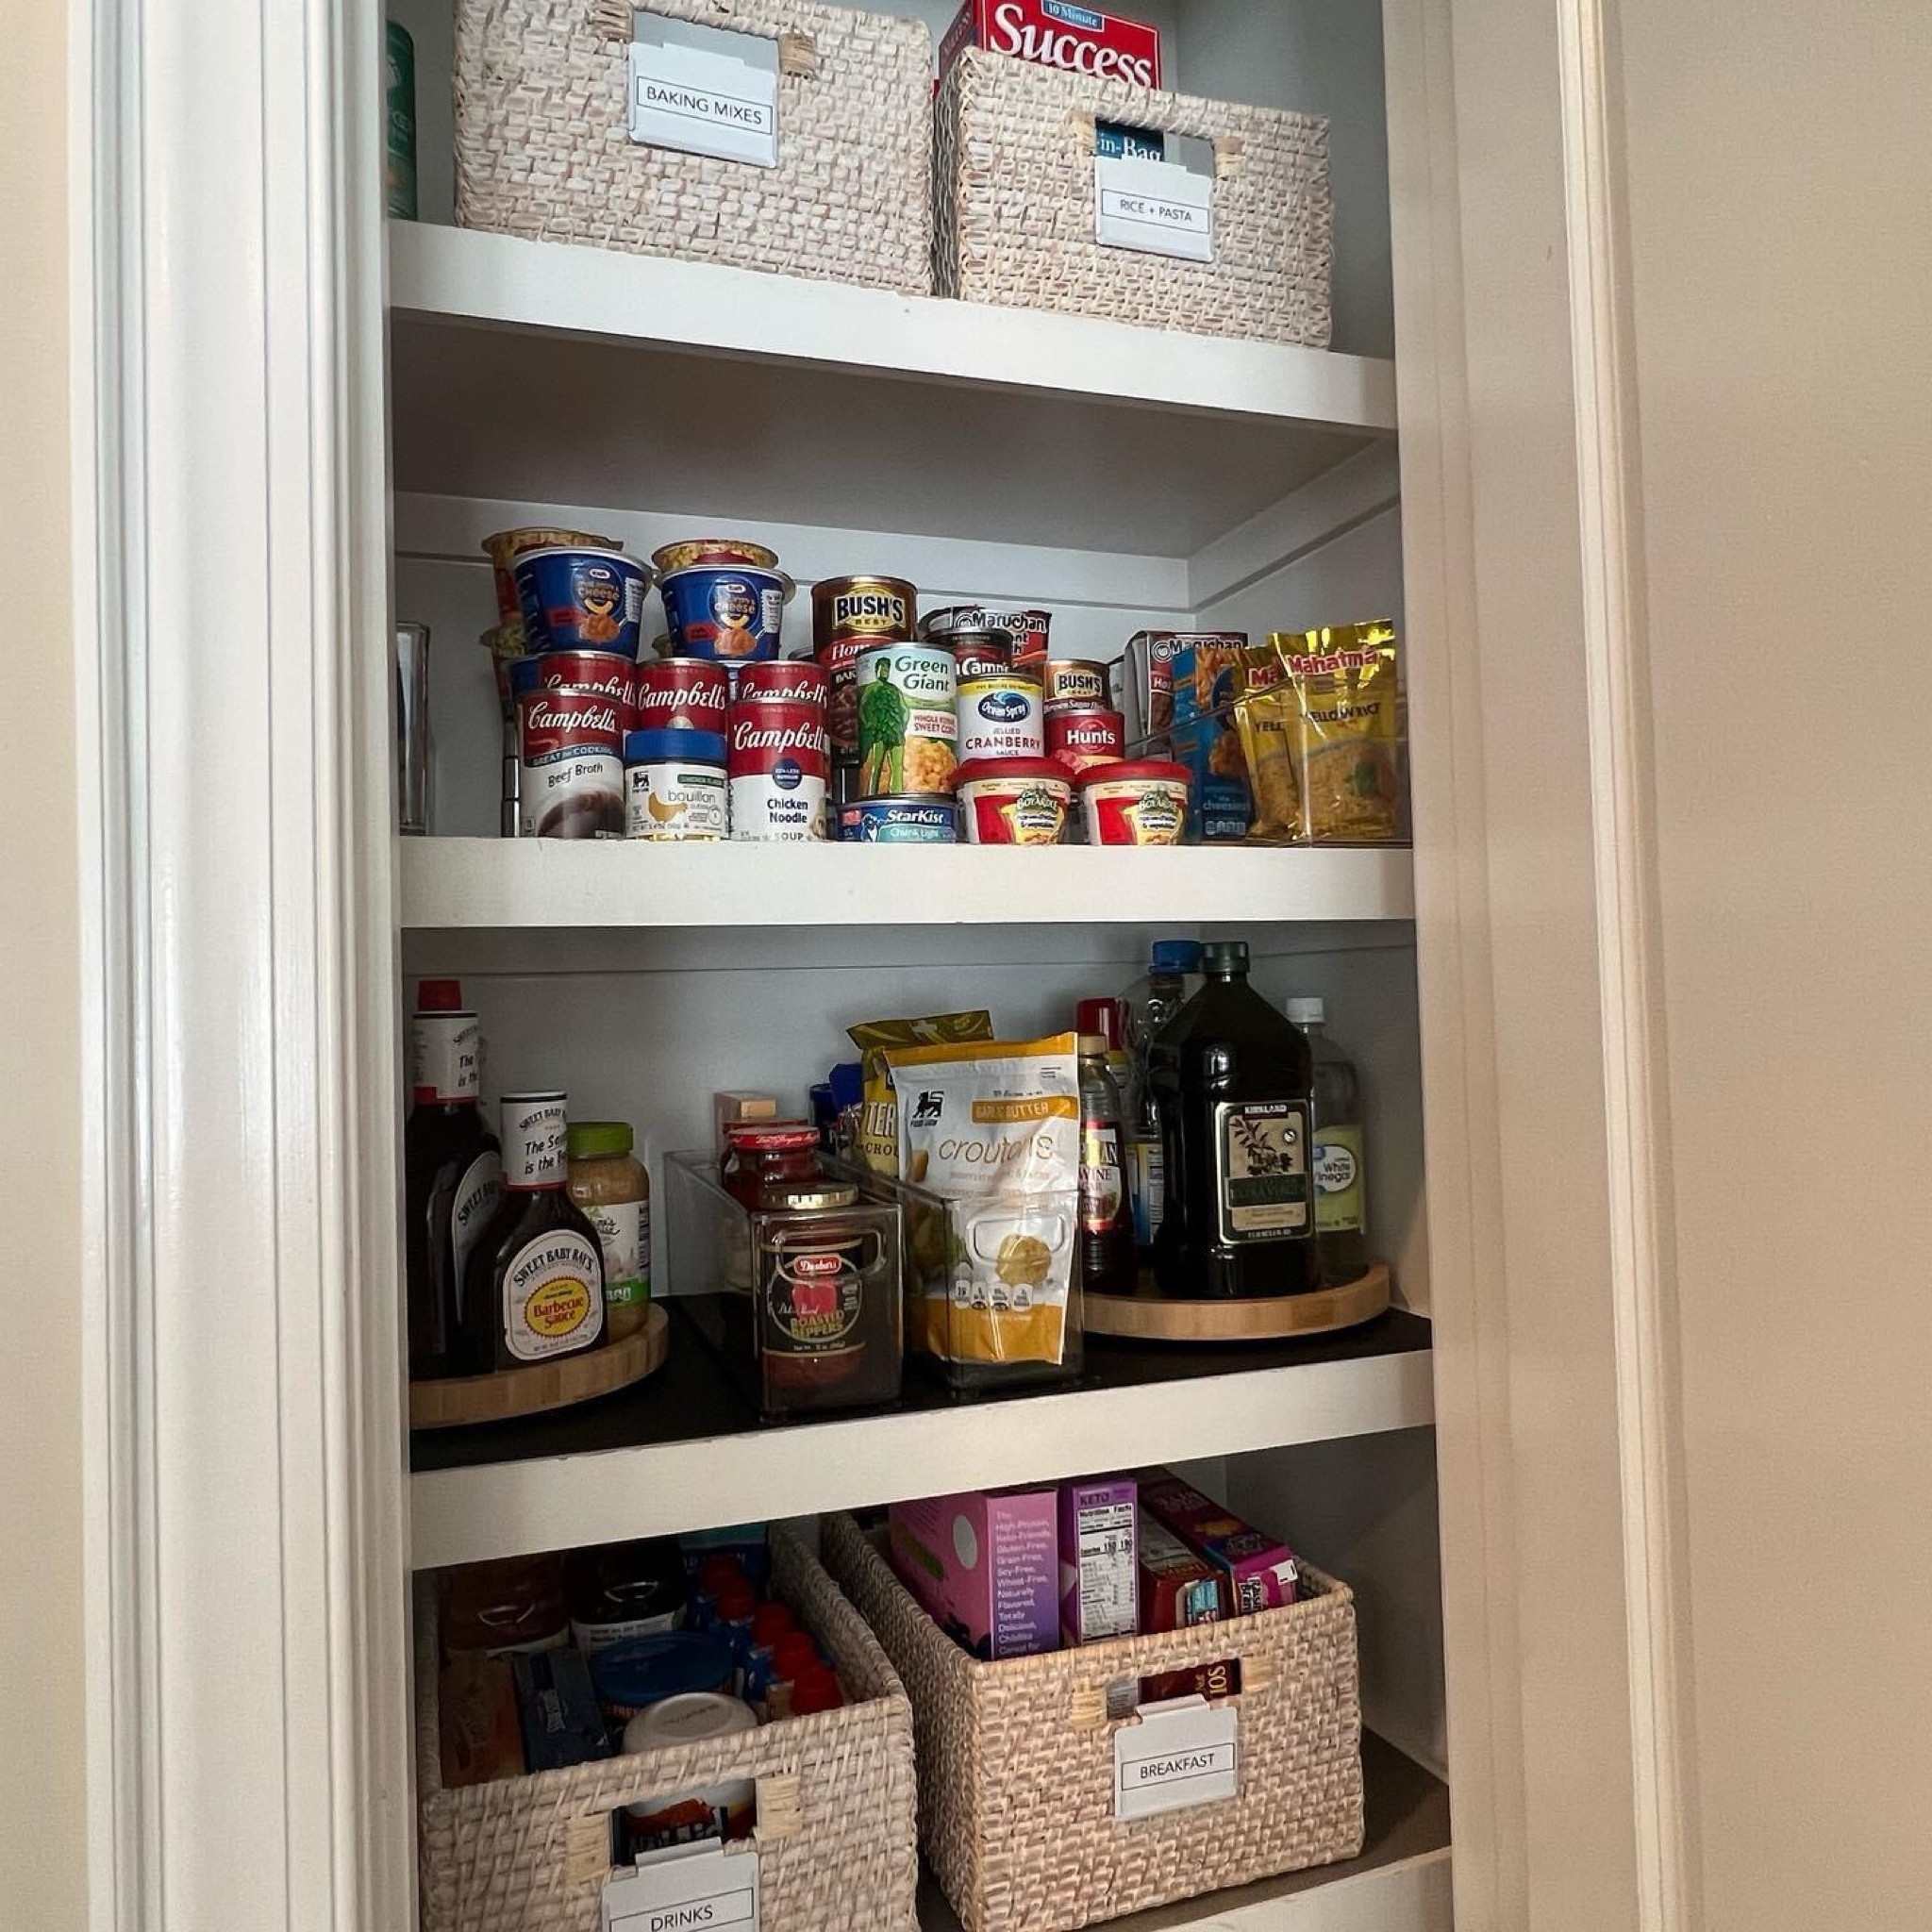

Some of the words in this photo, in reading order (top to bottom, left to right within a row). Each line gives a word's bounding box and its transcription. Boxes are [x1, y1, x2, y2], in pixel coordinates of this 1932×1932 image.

[1061, 7, 1099, 27] Minute
[990, 3, 1153, 89] Success
[647, 85, 709, 113] BAKING
[713, 100, 762, 125] MIXES
[1120, 198, 1145, 214] RICE
[1158, 205, 1193, 223] PASTA
[836, 595, 903, 624] BUSH'S
[973, 611, 1046, 631] Maruchan
[895, 656, 949, 675] Green
[1286, 647, 1381, 675] Mahatma
[903, 673, 949, 692] Giant
[639, 680, 725, 711] Campbell's
[528, 701, 619, 733] Campbell's
[914, 723, 941, 732] SWEET
[965, 736, 1041, 751] CRANBERRY
[547, 770, 573, 789] Beef
[575, 762, 604, 777] Broth
[667, 790, 716, 803] bouillon
[766, 797, 808, 810] Chicken
[769, 811, 808, 824] Noodle
[886, 809, 944, 824] StarKist
[525, 1141, 545, 1157] The
[525, 1161, 534, 1175] is
[539, 1156, 555, 1172] the
[513, 1254, 545, 1288] SWEET
[545, 1247, 572, 1263] BABY
[533, 1295, 585, 1317] Barbecue
[544, 1307, 577, 1329] Sauce
[1079, 1492, 1110, 1507] KETO
[1140, 1753, 1216, 1779] BREAKFAST
[650, 1904, 714, 1932] DRINKS
